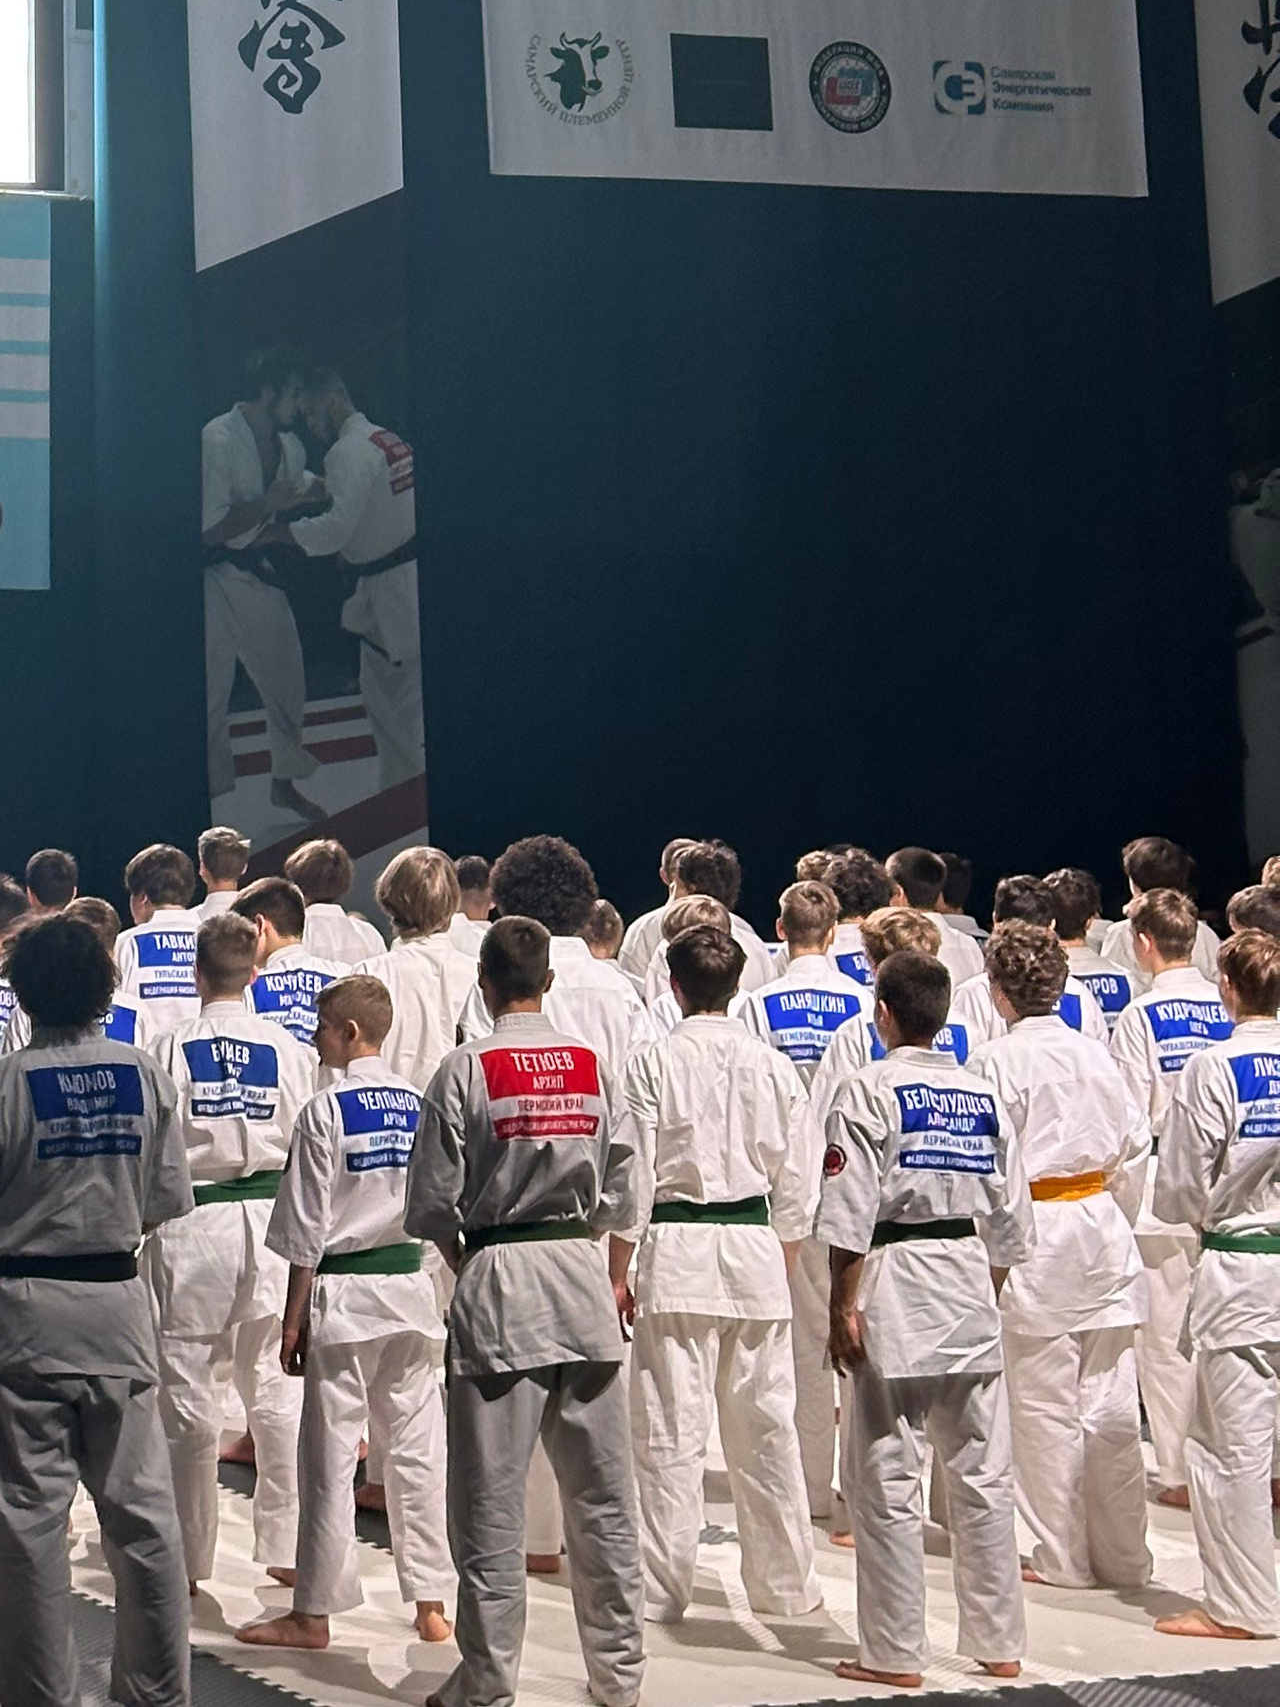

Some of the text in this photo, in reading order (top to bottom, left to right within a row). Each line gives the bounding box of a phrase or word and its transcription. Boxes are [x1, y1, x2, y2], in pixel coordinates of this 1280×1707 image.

[990, 65, 1056, 82] Самарская
[992, 80, 1092, 97] Энергетическая
[992, 98, 1055, 113] Компания
[153, 934, 195, 951] ТАВКИ
[171, 951, 196, 963] АНТО
[779, 992, 847, 1015] ПАНЯШКИН
[510, 1051, 575, 1073] ТЕТЮЕВ
[533, 1074, 565, 1090] АРХИП
[902, 1088, 994, 1116] БЕЛСЛУДЦЕВ
